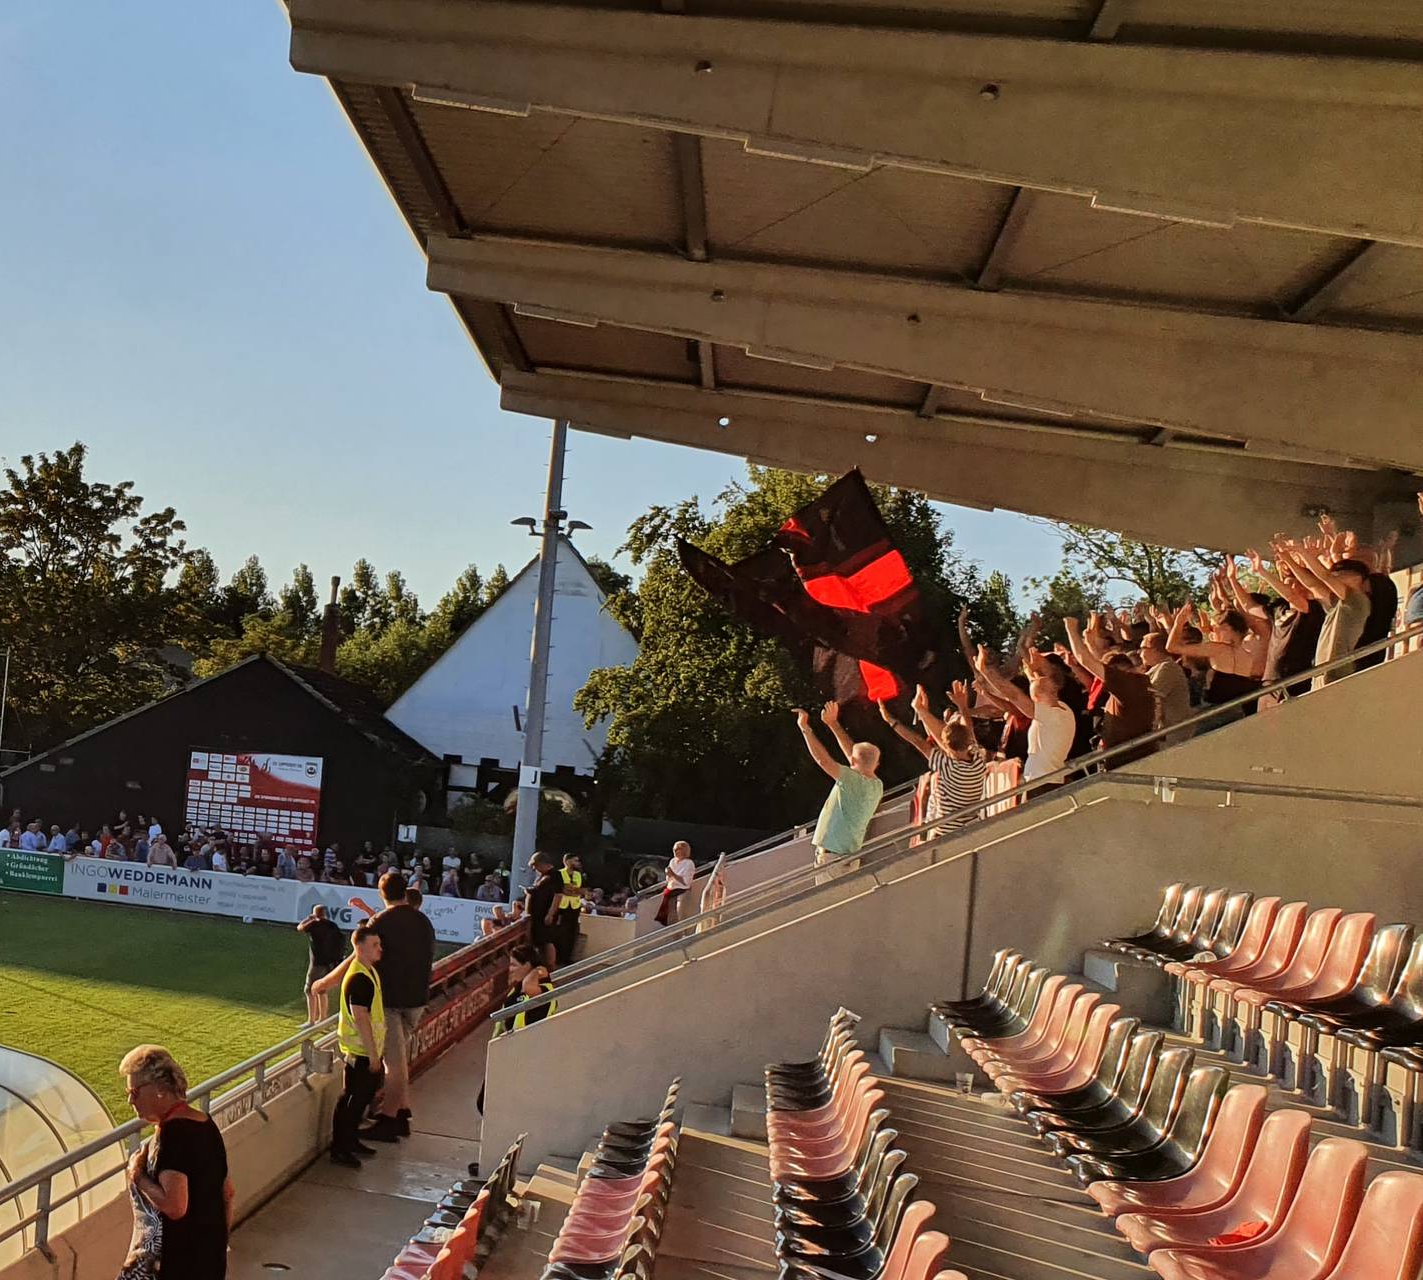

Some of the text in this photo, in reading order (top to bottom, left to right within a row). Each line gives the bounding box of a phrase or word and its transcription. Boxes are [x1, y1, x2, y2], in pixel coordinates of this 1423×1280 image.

[530, 769, 538, 785] J
[132, 886, 212, 906] Malermeister
[312, 903, 353, 923] WG
